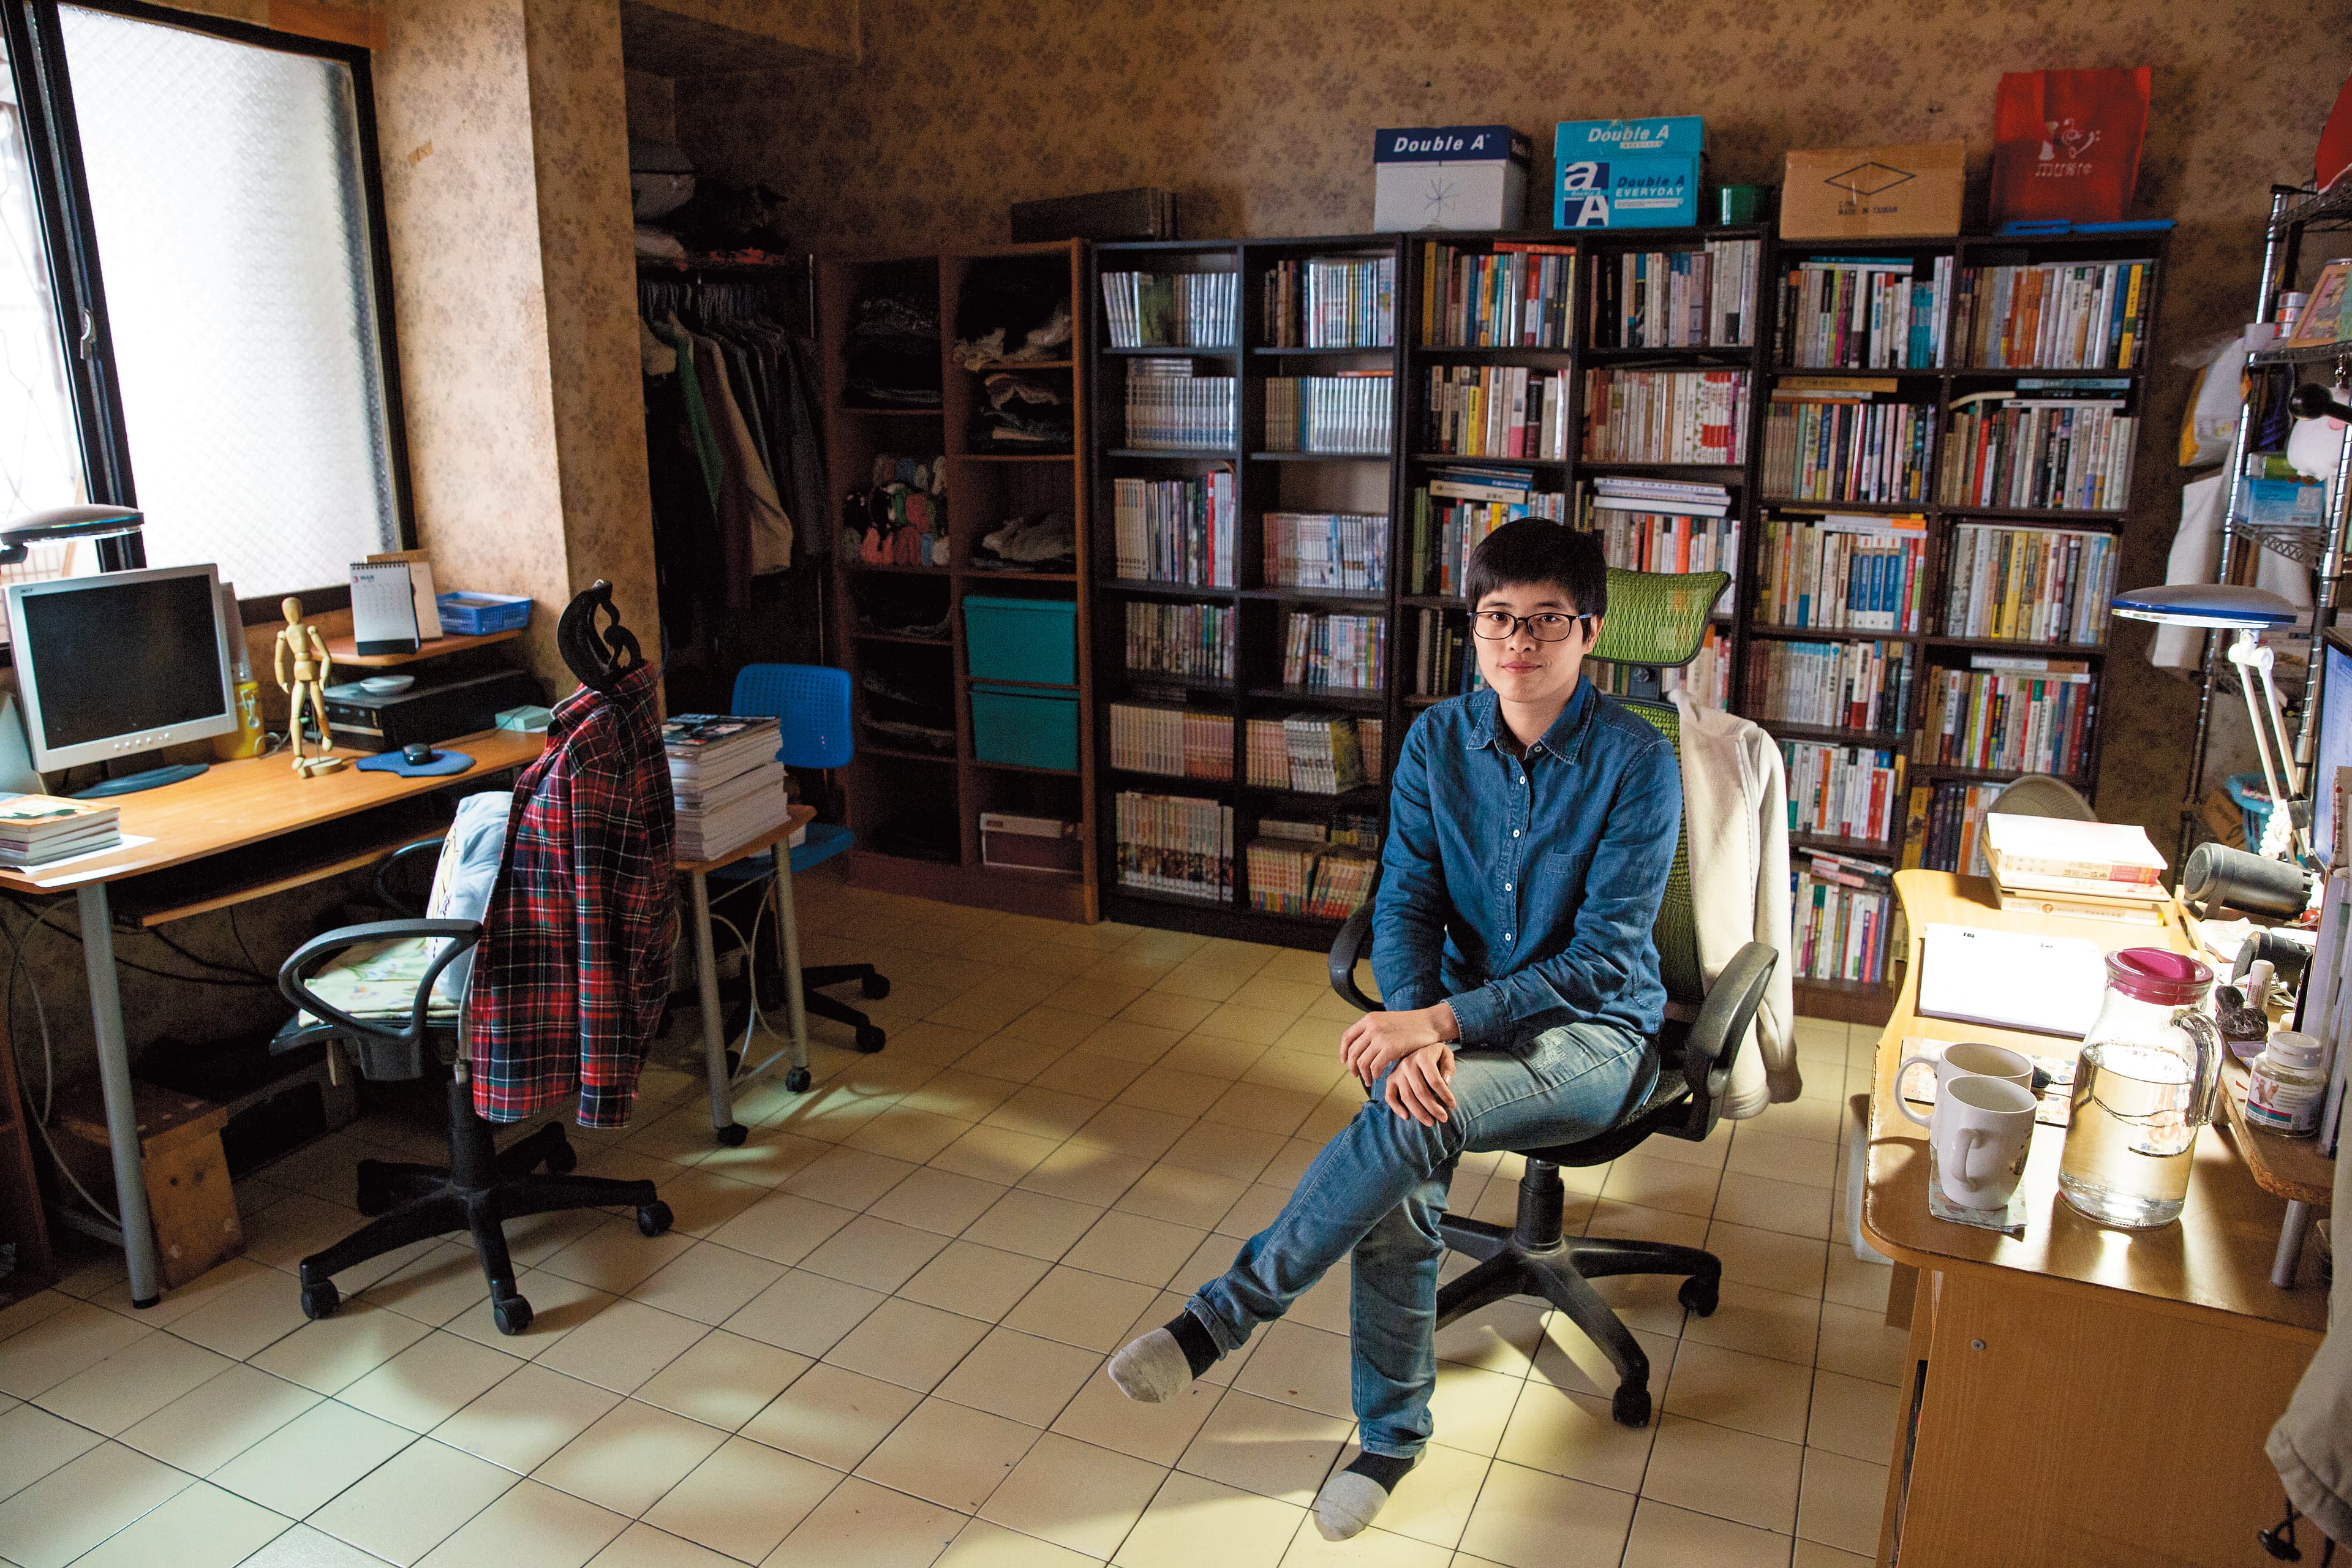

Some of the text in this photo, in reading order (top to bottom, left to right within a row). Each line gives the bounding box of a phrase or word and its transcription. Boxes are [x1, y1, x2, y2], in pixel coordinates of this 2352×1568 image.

[1588, 124, 1669, 142] Double A
[1393, 135, 1464, 153] Double
[1617, 175, 1684, 187] Double A
[1615, 186, 1683, 197] EVERYDAY
